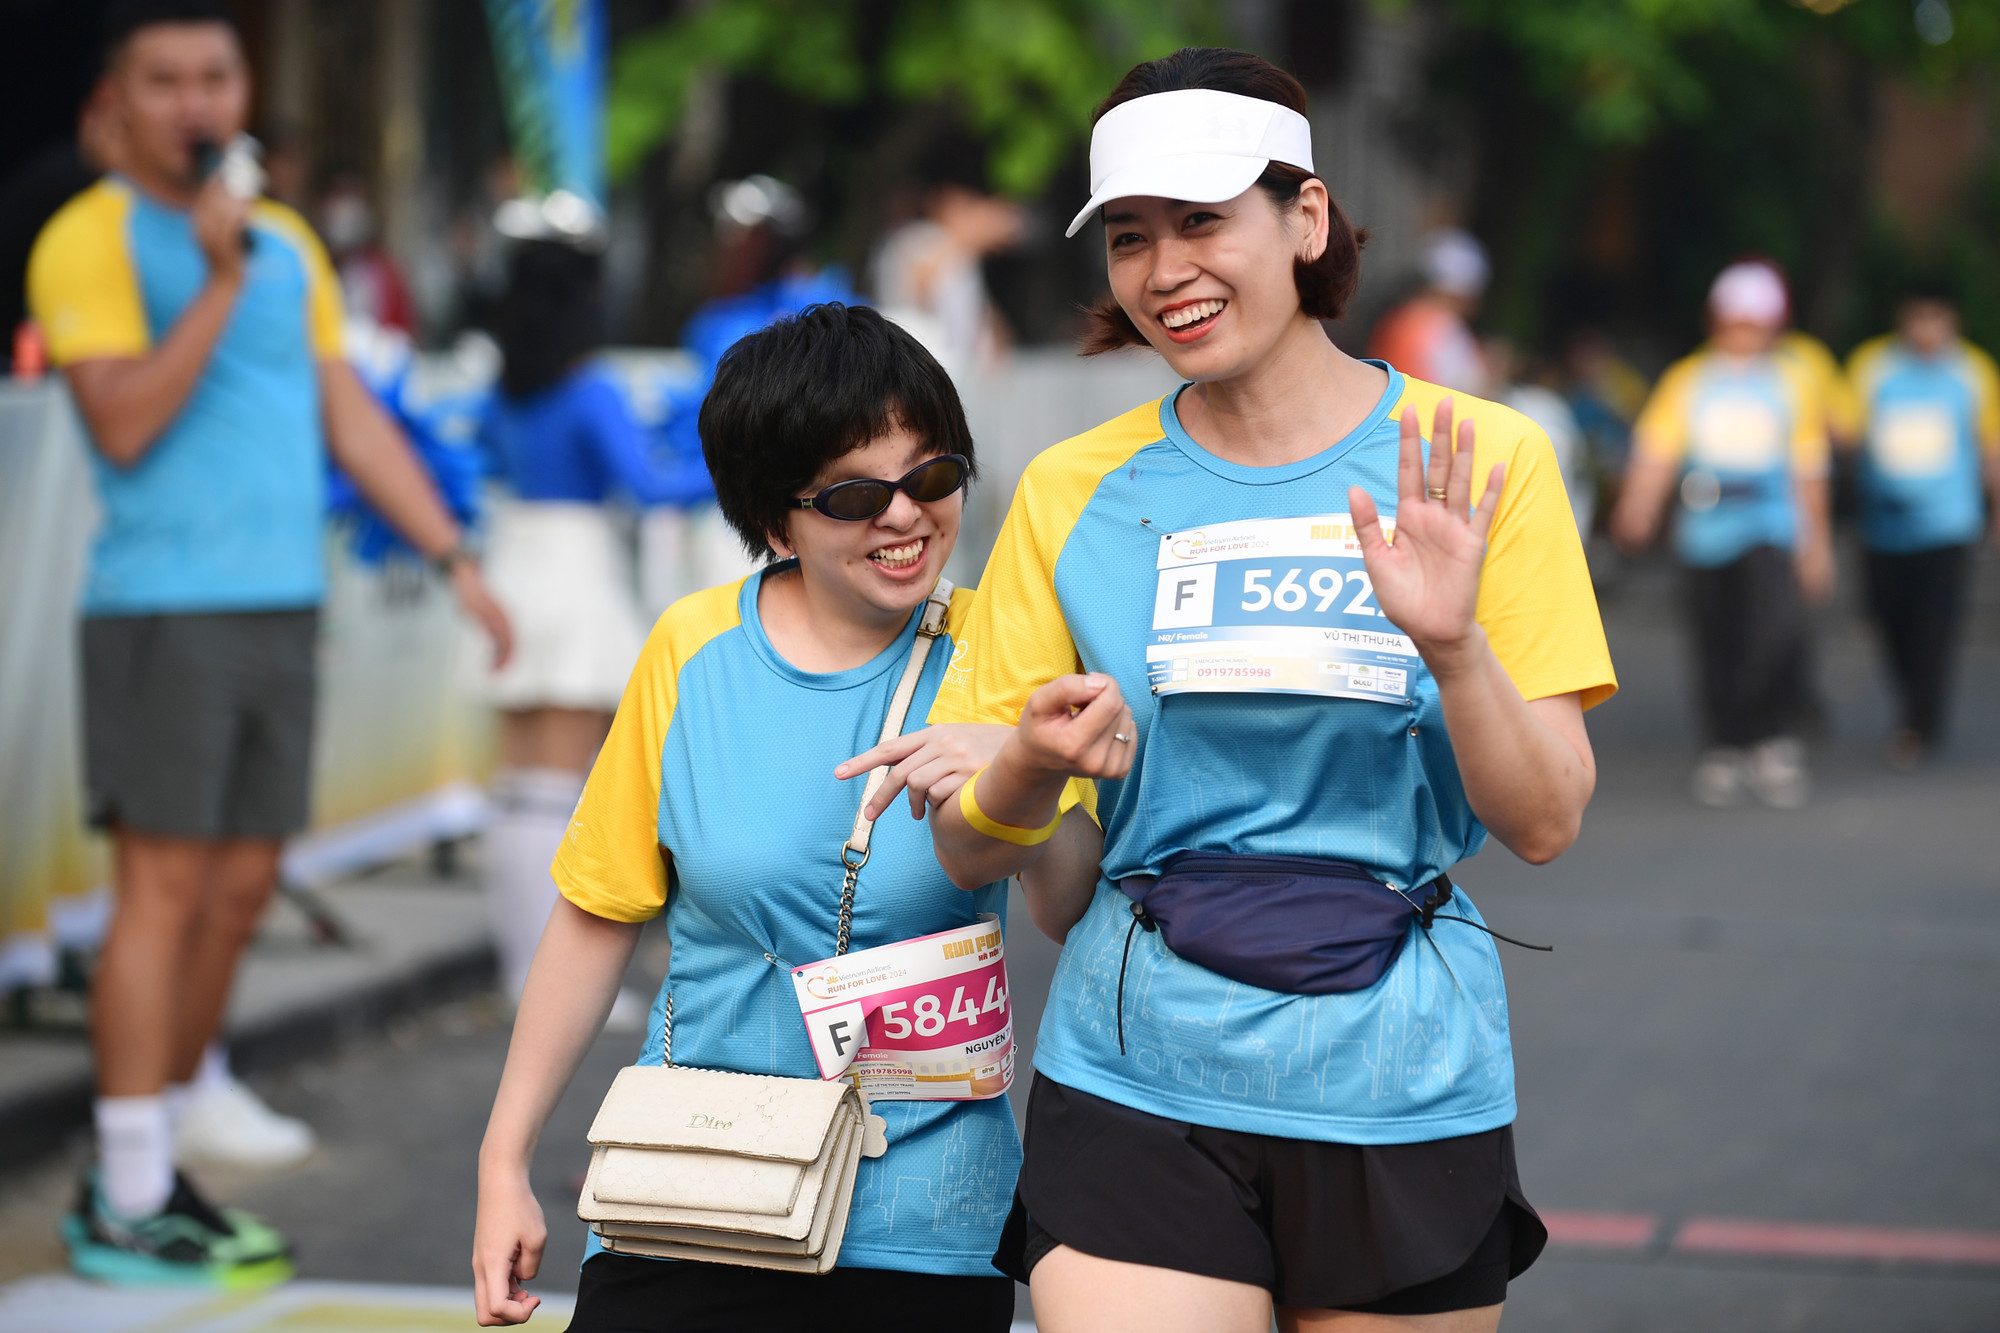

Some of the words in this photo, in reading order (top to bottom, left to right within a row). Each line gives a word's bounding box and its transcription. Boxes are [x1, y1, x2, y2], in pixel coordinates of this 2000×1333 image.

[1310, 525, 1342, 540] RUN
[1189, 547, 1208, 555] RUN
[1210, 545, 1226, 553] FOR
[1228, 542, 1249, 551] LOVE
[1251, 541, 1270, 549] 2024
[1174, 579, 1197, 611] F
[1241, 568, 1386, 618] 5692
[1176, 631, 1209, 641] Female
[1324, 630, 1340, 641] VŨ
[1342, 632, 1360, 645] THỊ
[1362, 634, 1384, 645] THU
[1386, 636, 1402, 648] HÀ
[1197, 667, 1271, 678] 0919785998
[942, 938, 975, 960] RUN
[827, 984, 847, 995] RUN
[847, 979, 864, 989] FOR
[866, 973, 887, 984] LOVE
[889, 968, 907, 979] 2024
[881, 976, 1008, 1040] 5844
[828, 1021, 851, 1057] F
